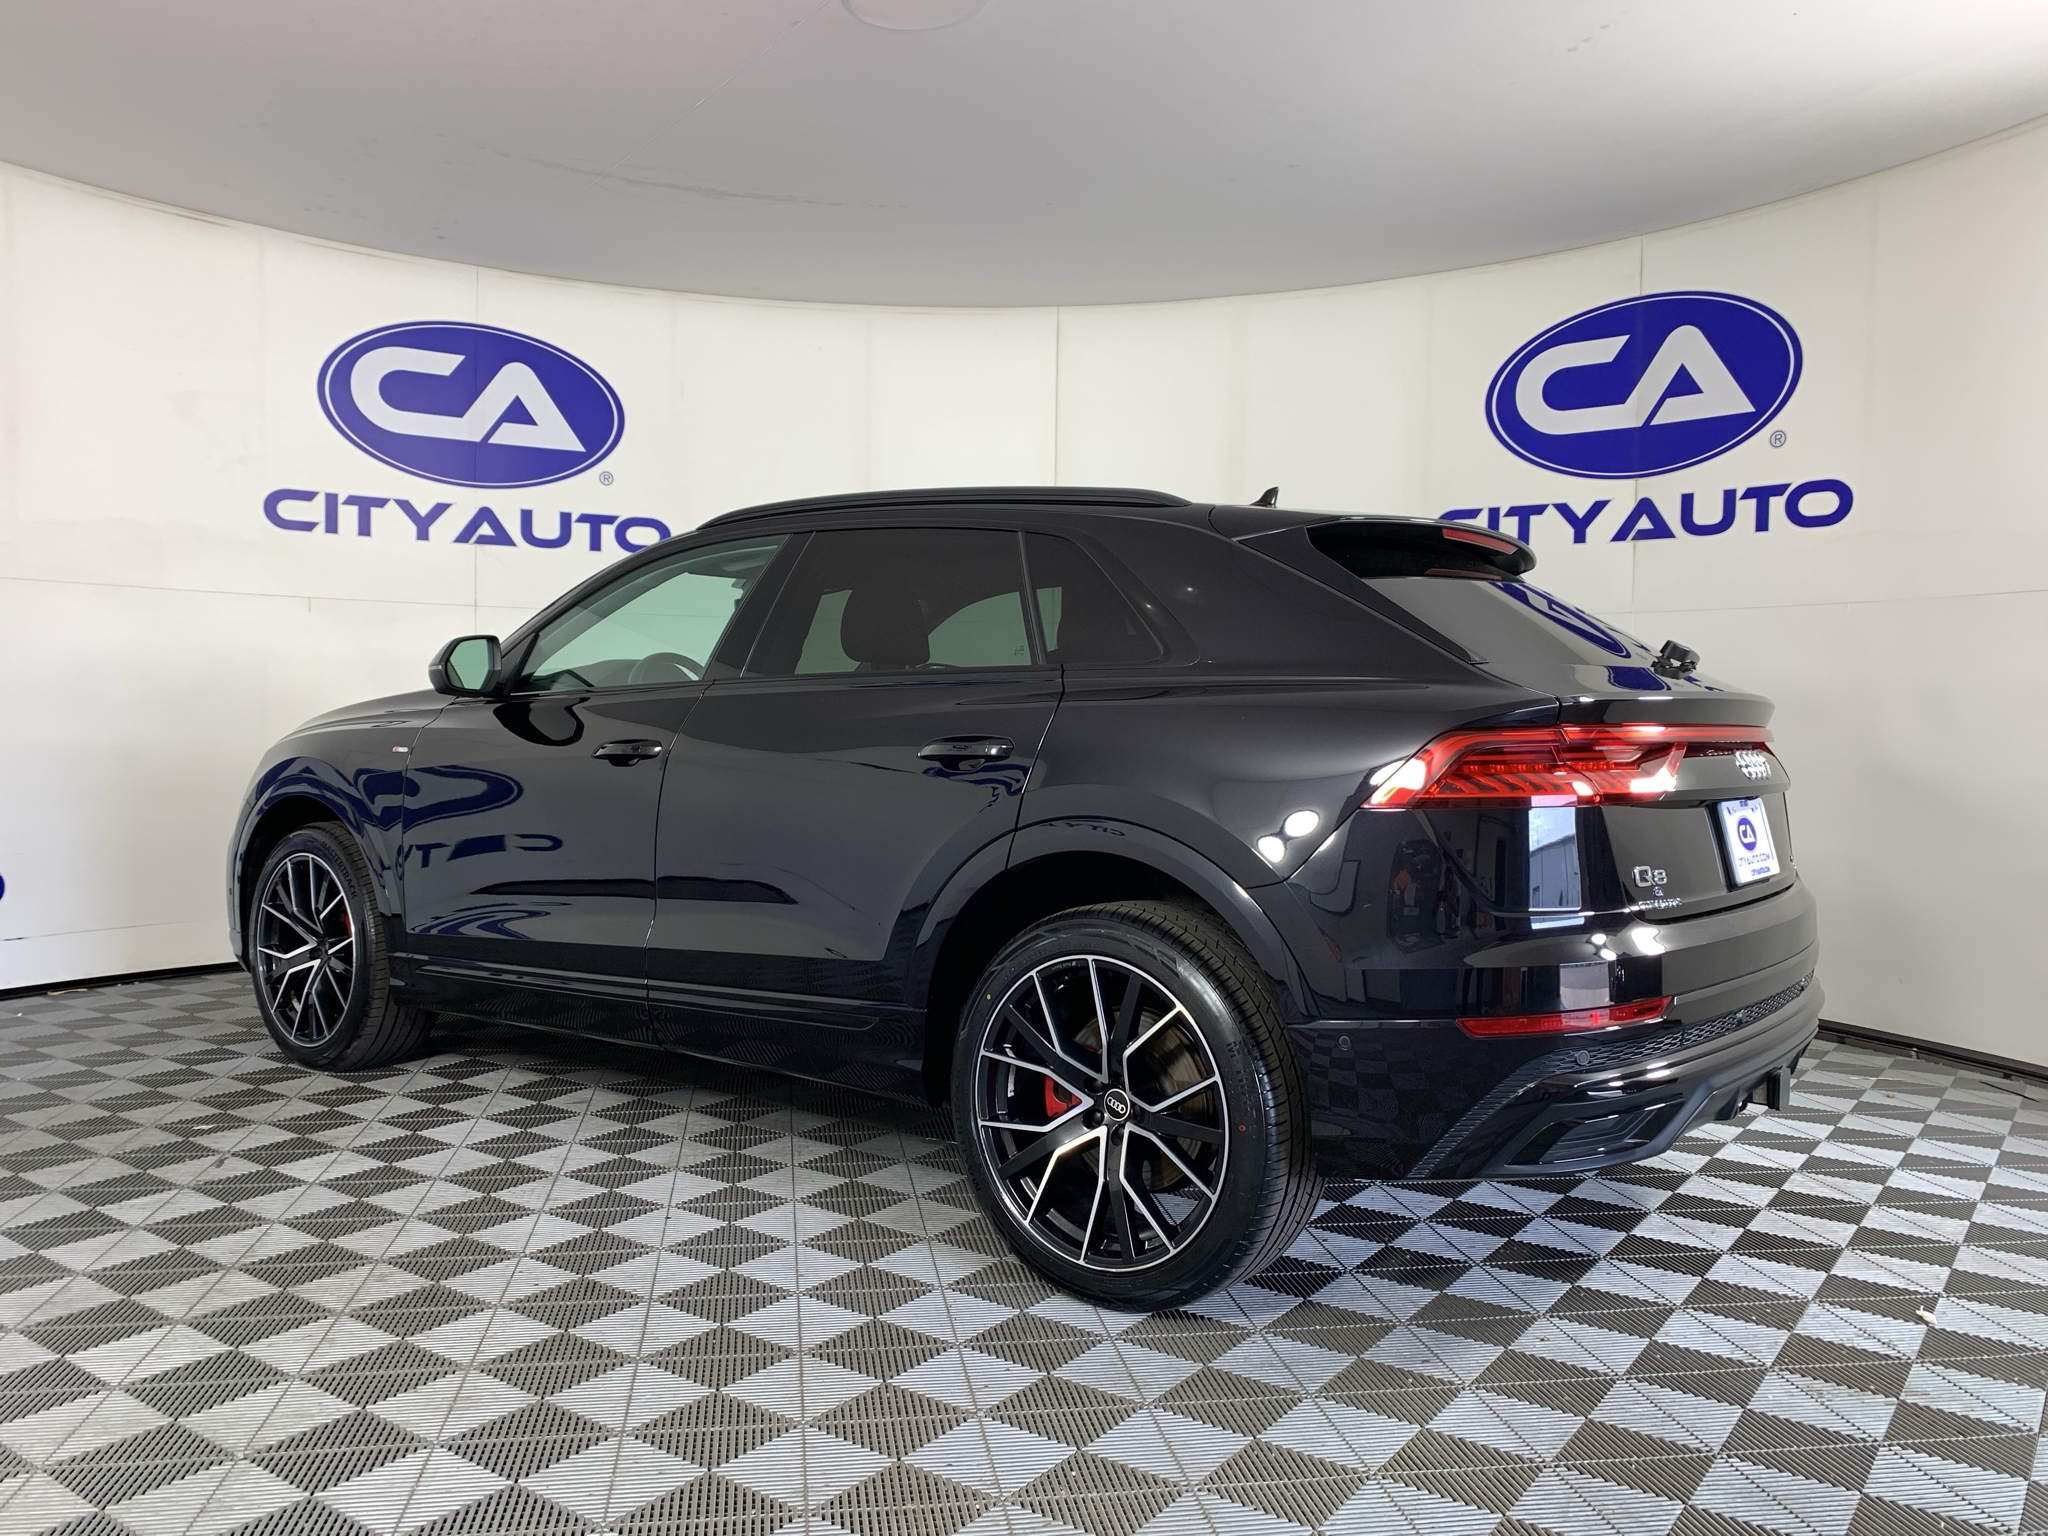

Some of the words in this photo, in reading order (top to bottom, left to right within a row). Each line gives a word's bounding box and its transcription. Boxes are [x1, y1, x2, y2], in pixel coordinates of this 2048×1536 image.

[350, 346, 587, 452] CA
[1515, 324, 1757, 435] CA
[1632, 865, 1668, 887] Q8
